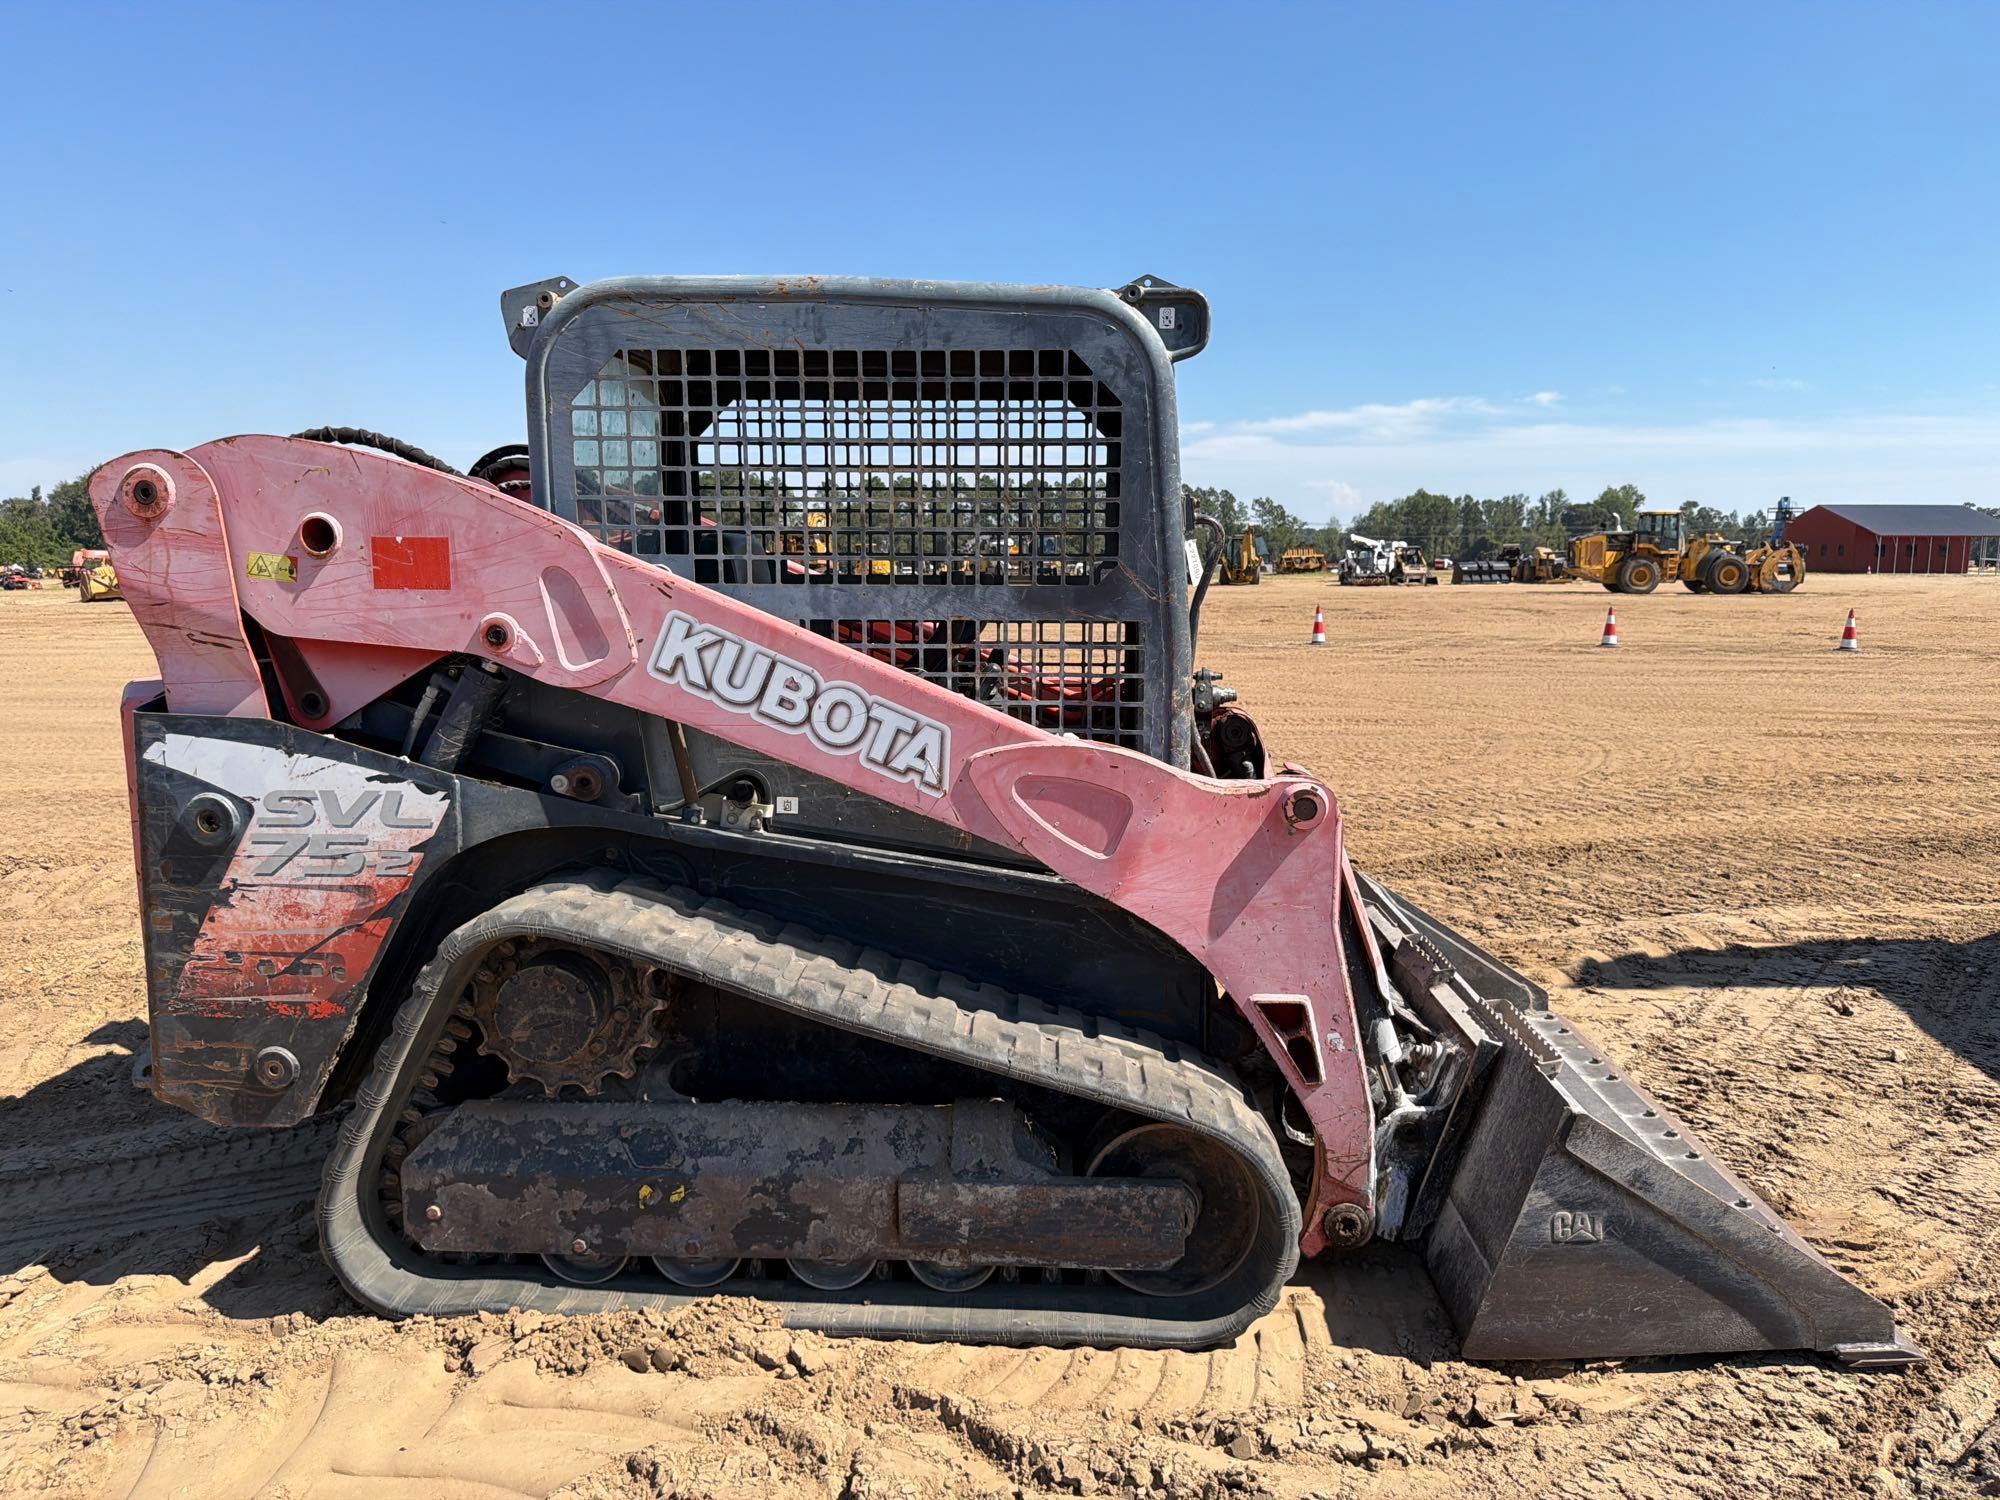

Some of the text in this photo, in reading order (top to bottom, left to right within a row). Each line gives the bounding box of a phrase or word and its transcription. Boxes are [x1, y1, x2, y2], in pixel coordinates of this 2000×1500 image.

[652, 613, 947, 794] KUBOTA
[257, 789, 434, 828] SVL
[250, 833, 414, 877] 75-2
[1550, 1211, 1603, 1242] CAT
